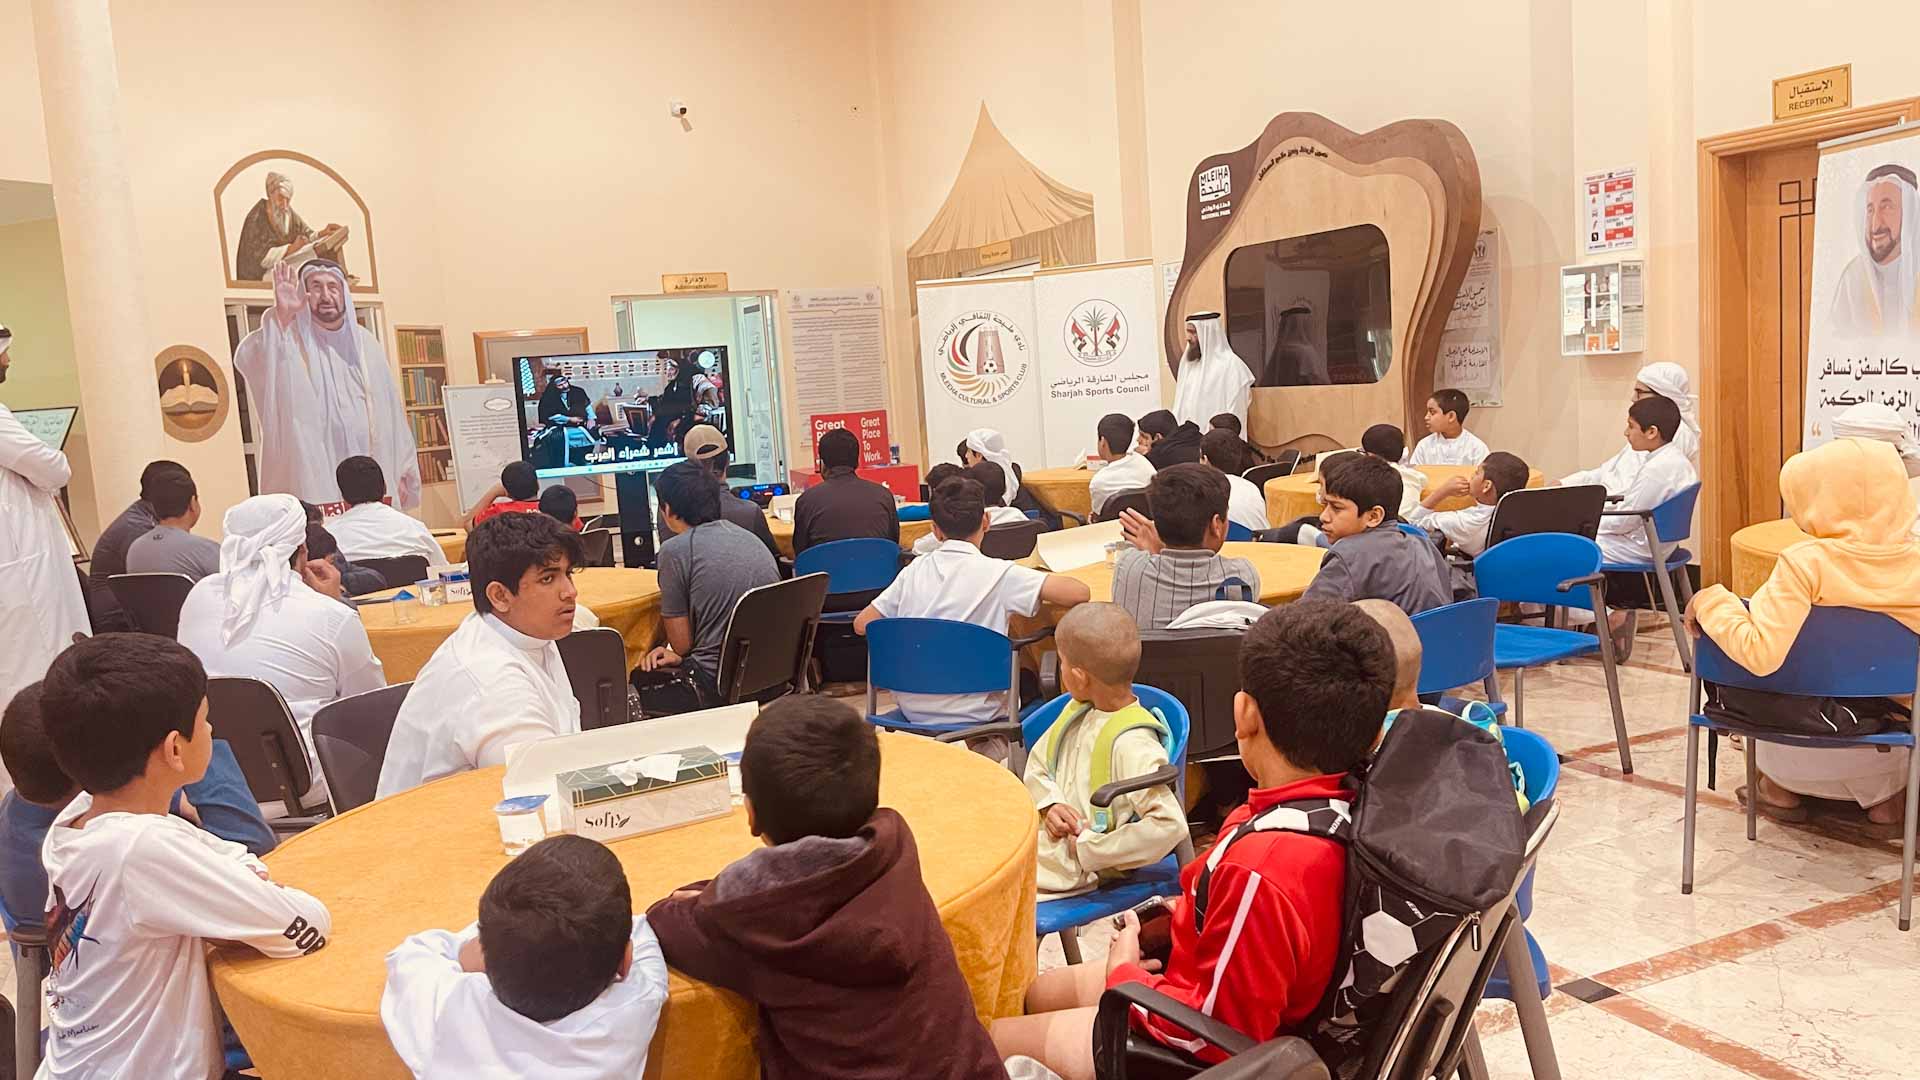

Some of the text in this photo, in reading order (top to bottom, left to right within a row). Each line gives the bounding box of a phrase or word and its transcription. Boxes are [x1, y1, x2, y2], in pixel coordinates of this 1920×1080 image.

[1788, 95, 1834, 111] RECEPTION
[1200, 166, 1229, 183] MLEIHA
[1818, 357, 1852, 380] نسافر
[1854, 356, 1908, 381] كالسفن
[958, 393, 991, 405] CULTURAL
[997, 380, 1020, 401] SPORTS
[1016, 363, 1028, 381] CLUB
[1050, 371, 1149, 389] مجلس الشارقة الرياضي
[1050, 384, 1150, 399] Sharjah Sports Council
[814, 419, 846, 431] Great
[860, 416, 881, 428] Great
[861, 428, 881, 439] Place
[862, 440, 872, 451] To
[584, 447, 616, 464] العرب
